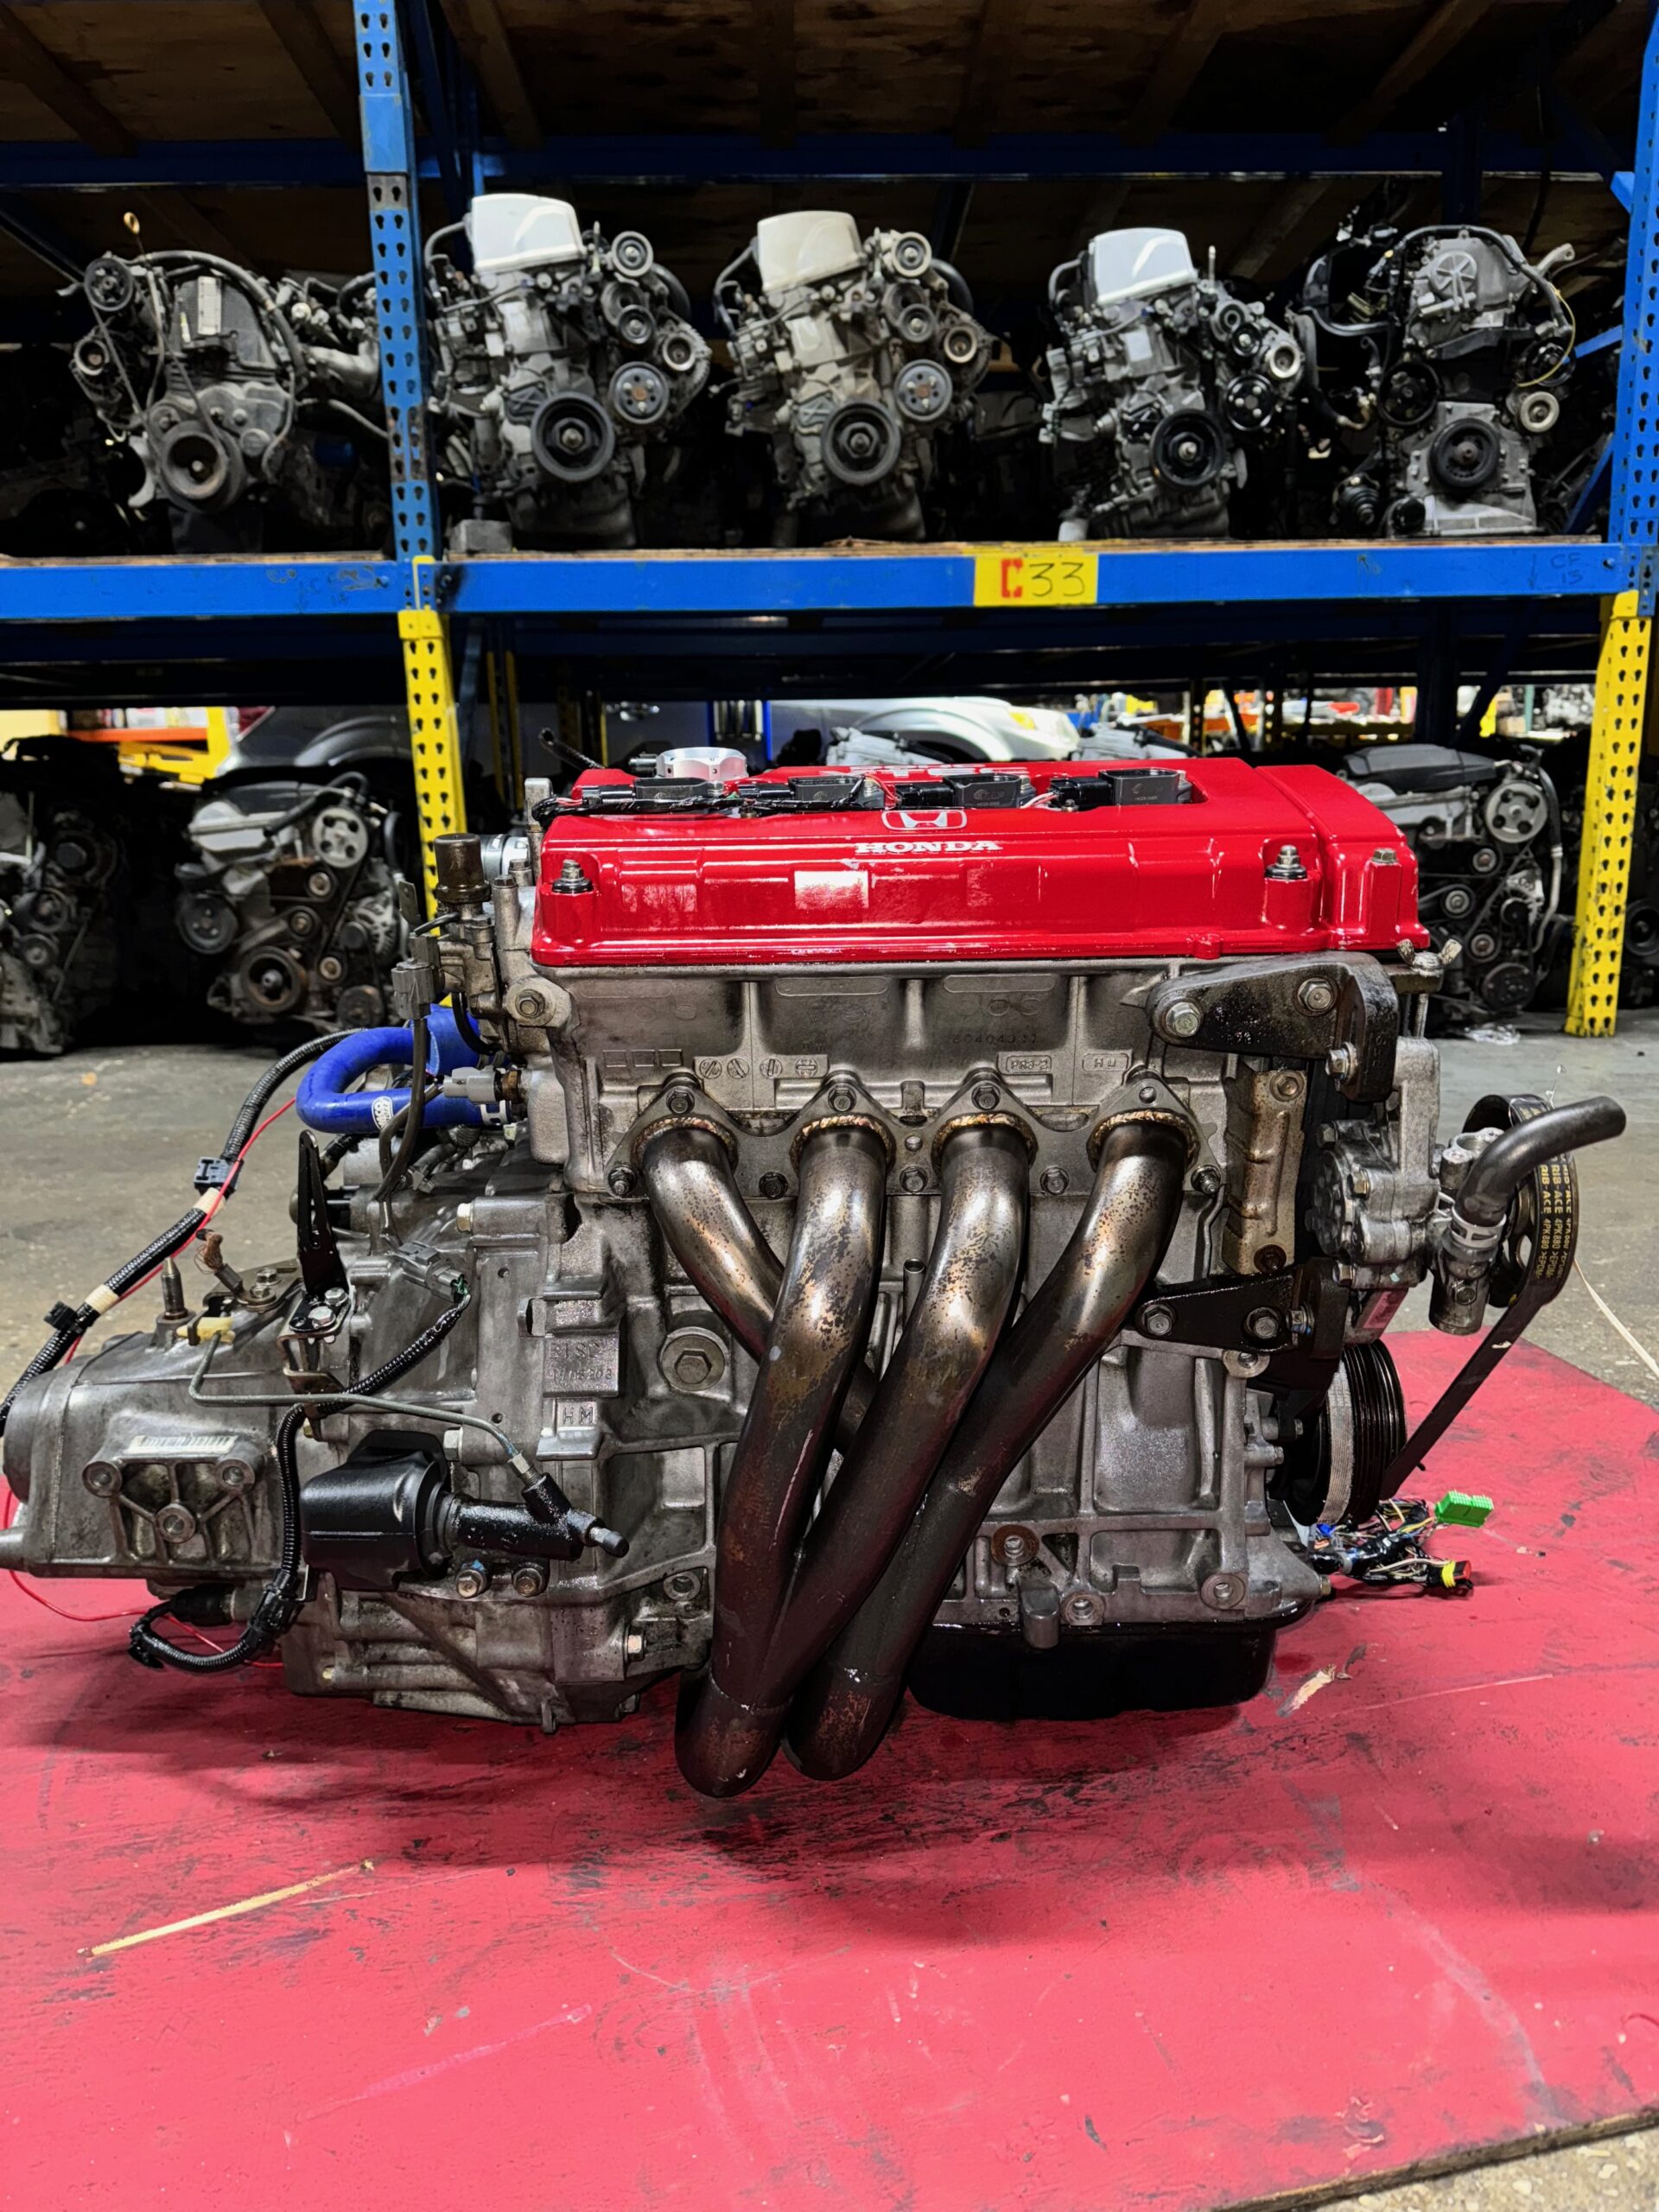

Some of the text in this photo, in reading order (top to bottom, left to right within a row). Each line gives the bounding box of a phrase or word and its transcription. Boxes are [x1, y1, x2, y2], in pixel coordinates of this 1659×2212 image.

[1001, 558, 1085, 599] C33
[855, 840, 1003, 855] HONDA
[1539, 1164, 1552, 1214] RIB-ACE
[1550, 1164, 1563, 1214] RIB-ACE
